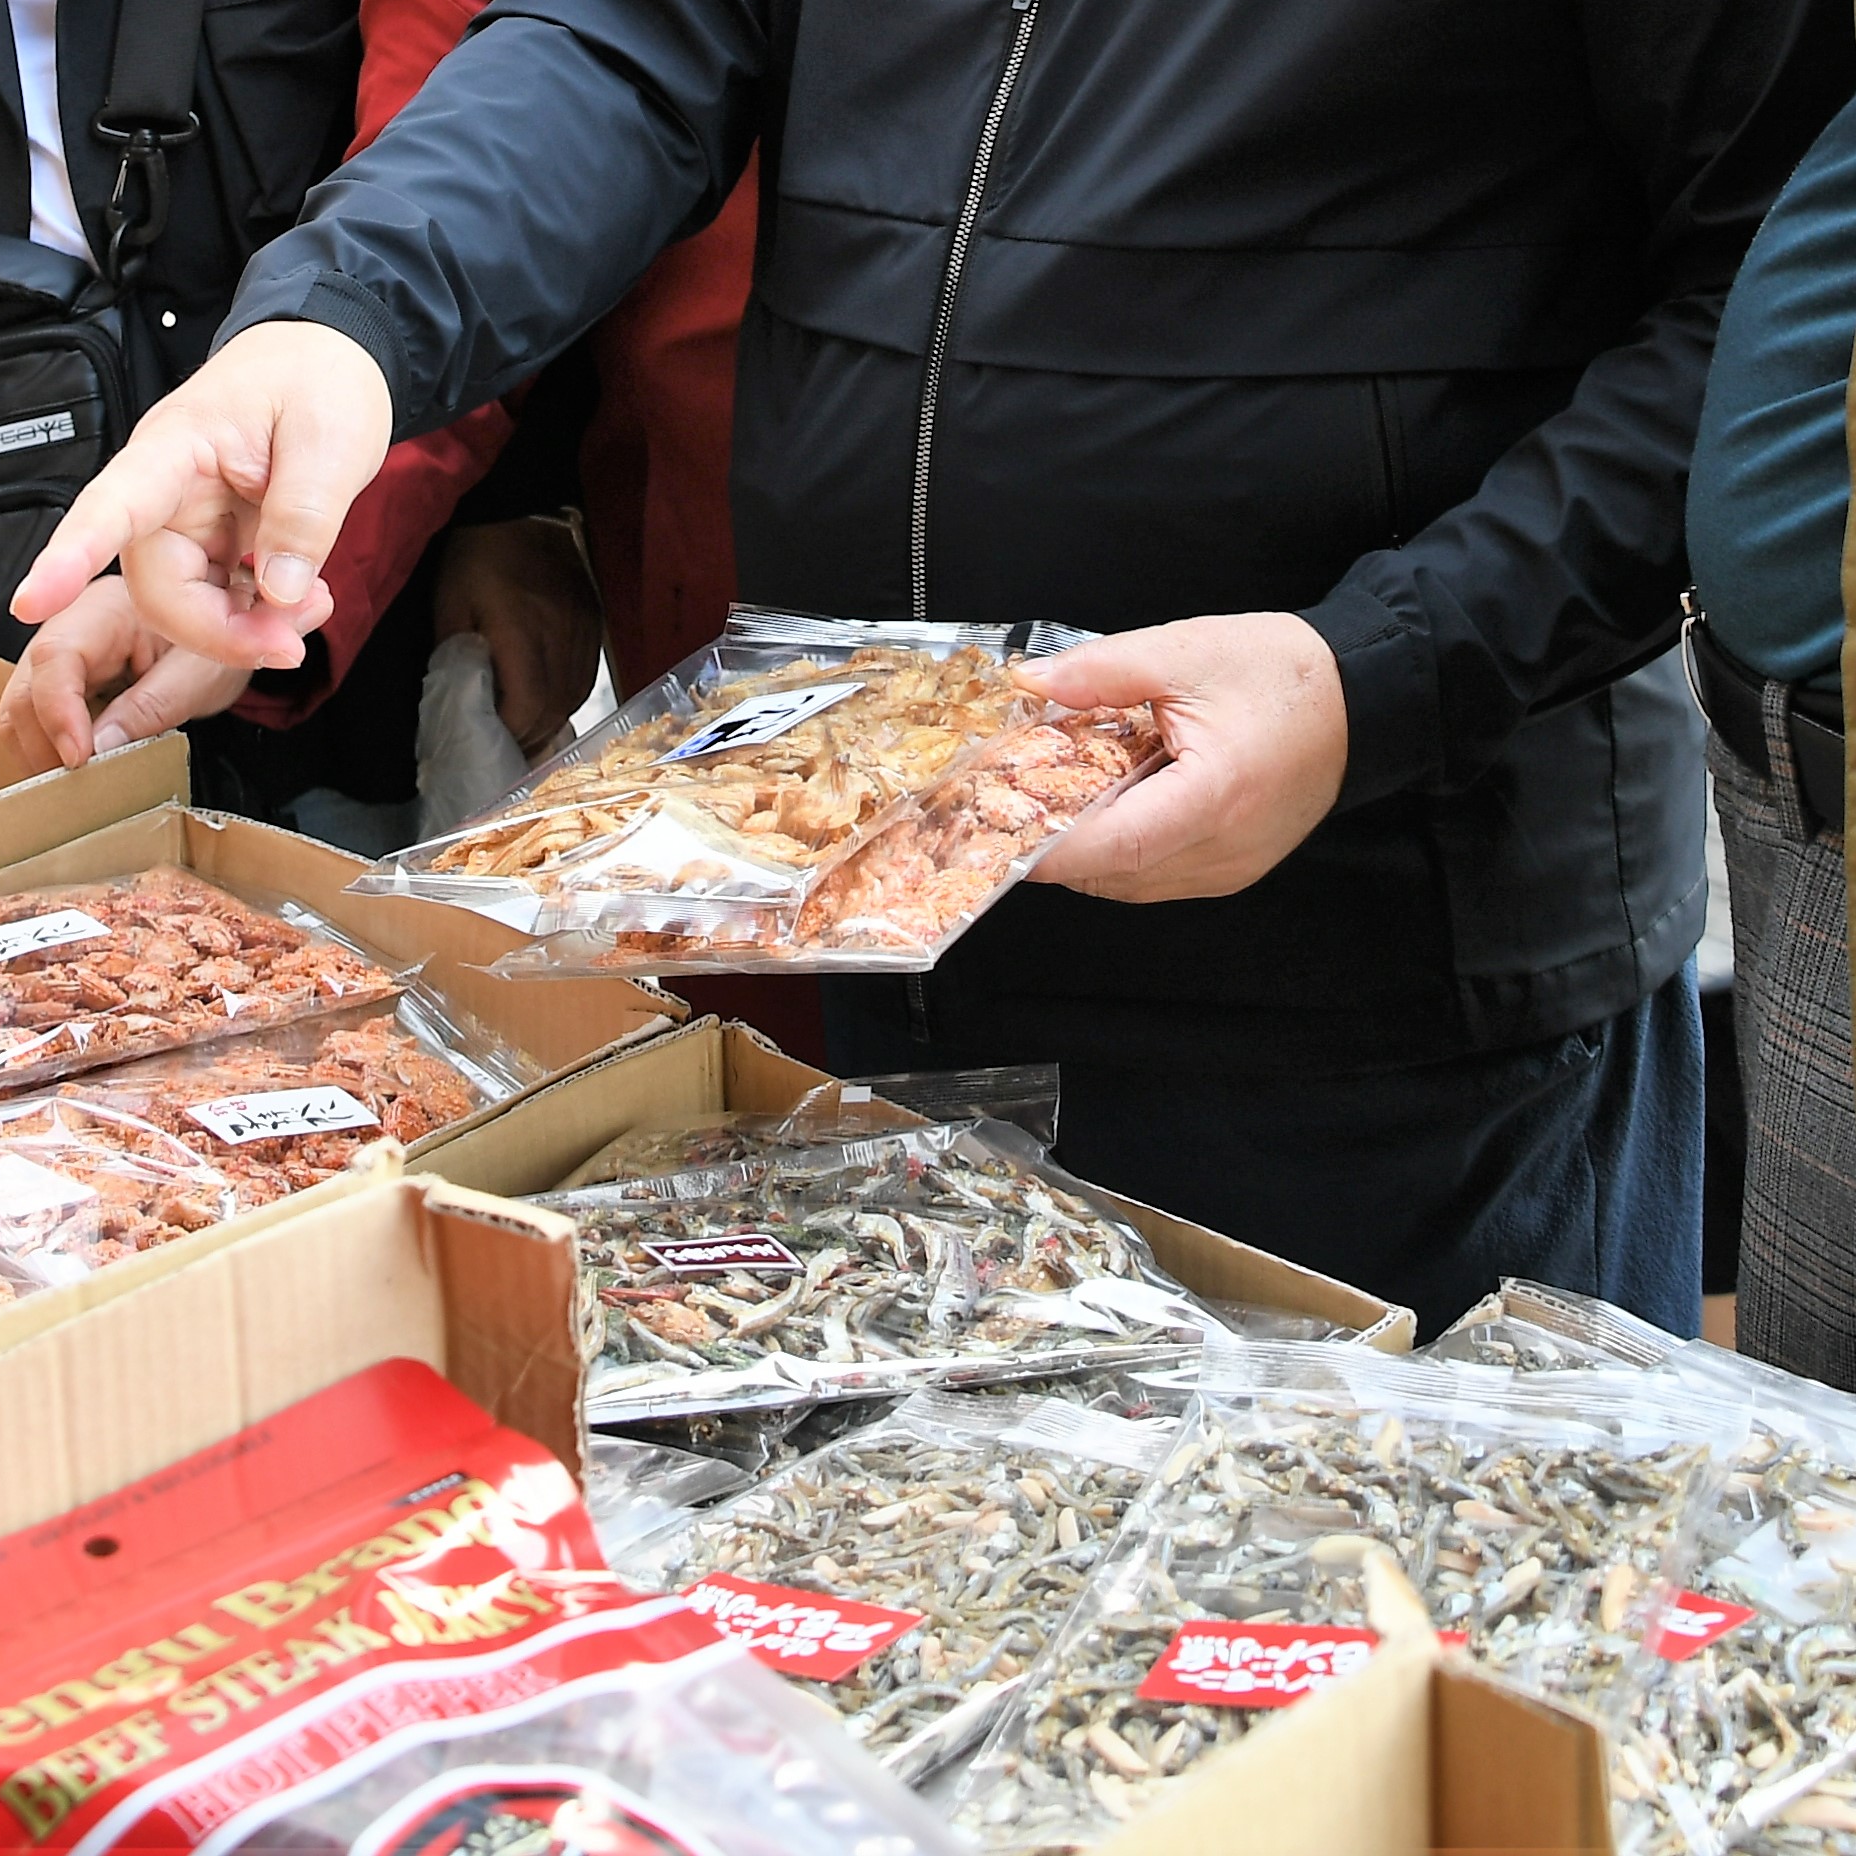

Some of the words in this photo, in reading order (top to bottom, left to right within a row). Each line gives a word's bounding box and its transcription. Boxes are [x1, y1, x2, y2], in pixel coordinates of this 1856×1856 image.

[212, 1478, 502, 1630] Brand
[167, 1606, 392, 1734] STEAK
[1166, 1634, 1371, 1678] モンド小魚
[153, 1726, 328, 1844] HOT
[316, 1662, 558, 1764] PEPPER
